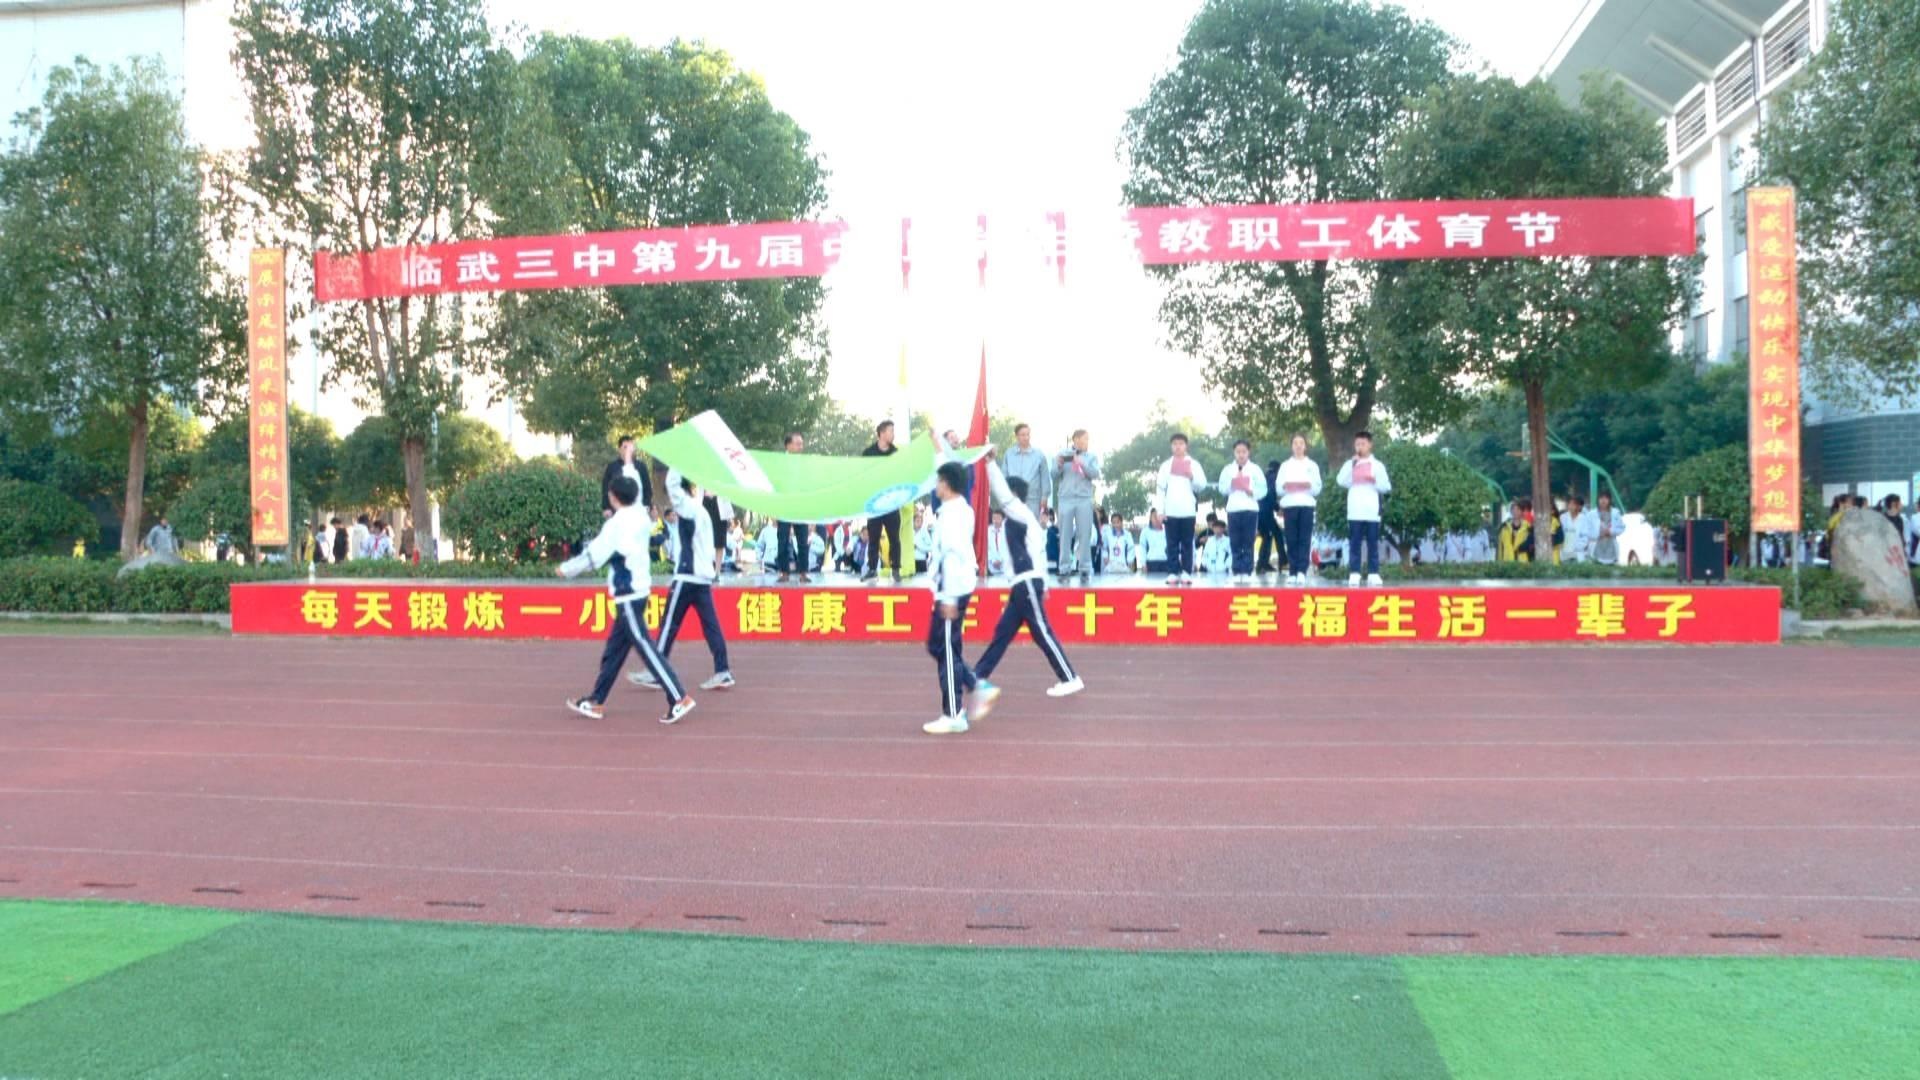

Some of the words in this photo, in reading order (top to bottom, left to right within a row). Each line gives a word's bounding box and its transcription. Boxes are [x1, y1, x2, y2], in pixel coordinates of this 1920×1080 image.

[736, 591, 1184, 637] 健康工十年
[1228, 593, 1696, 638] 幸福生活一辈子
